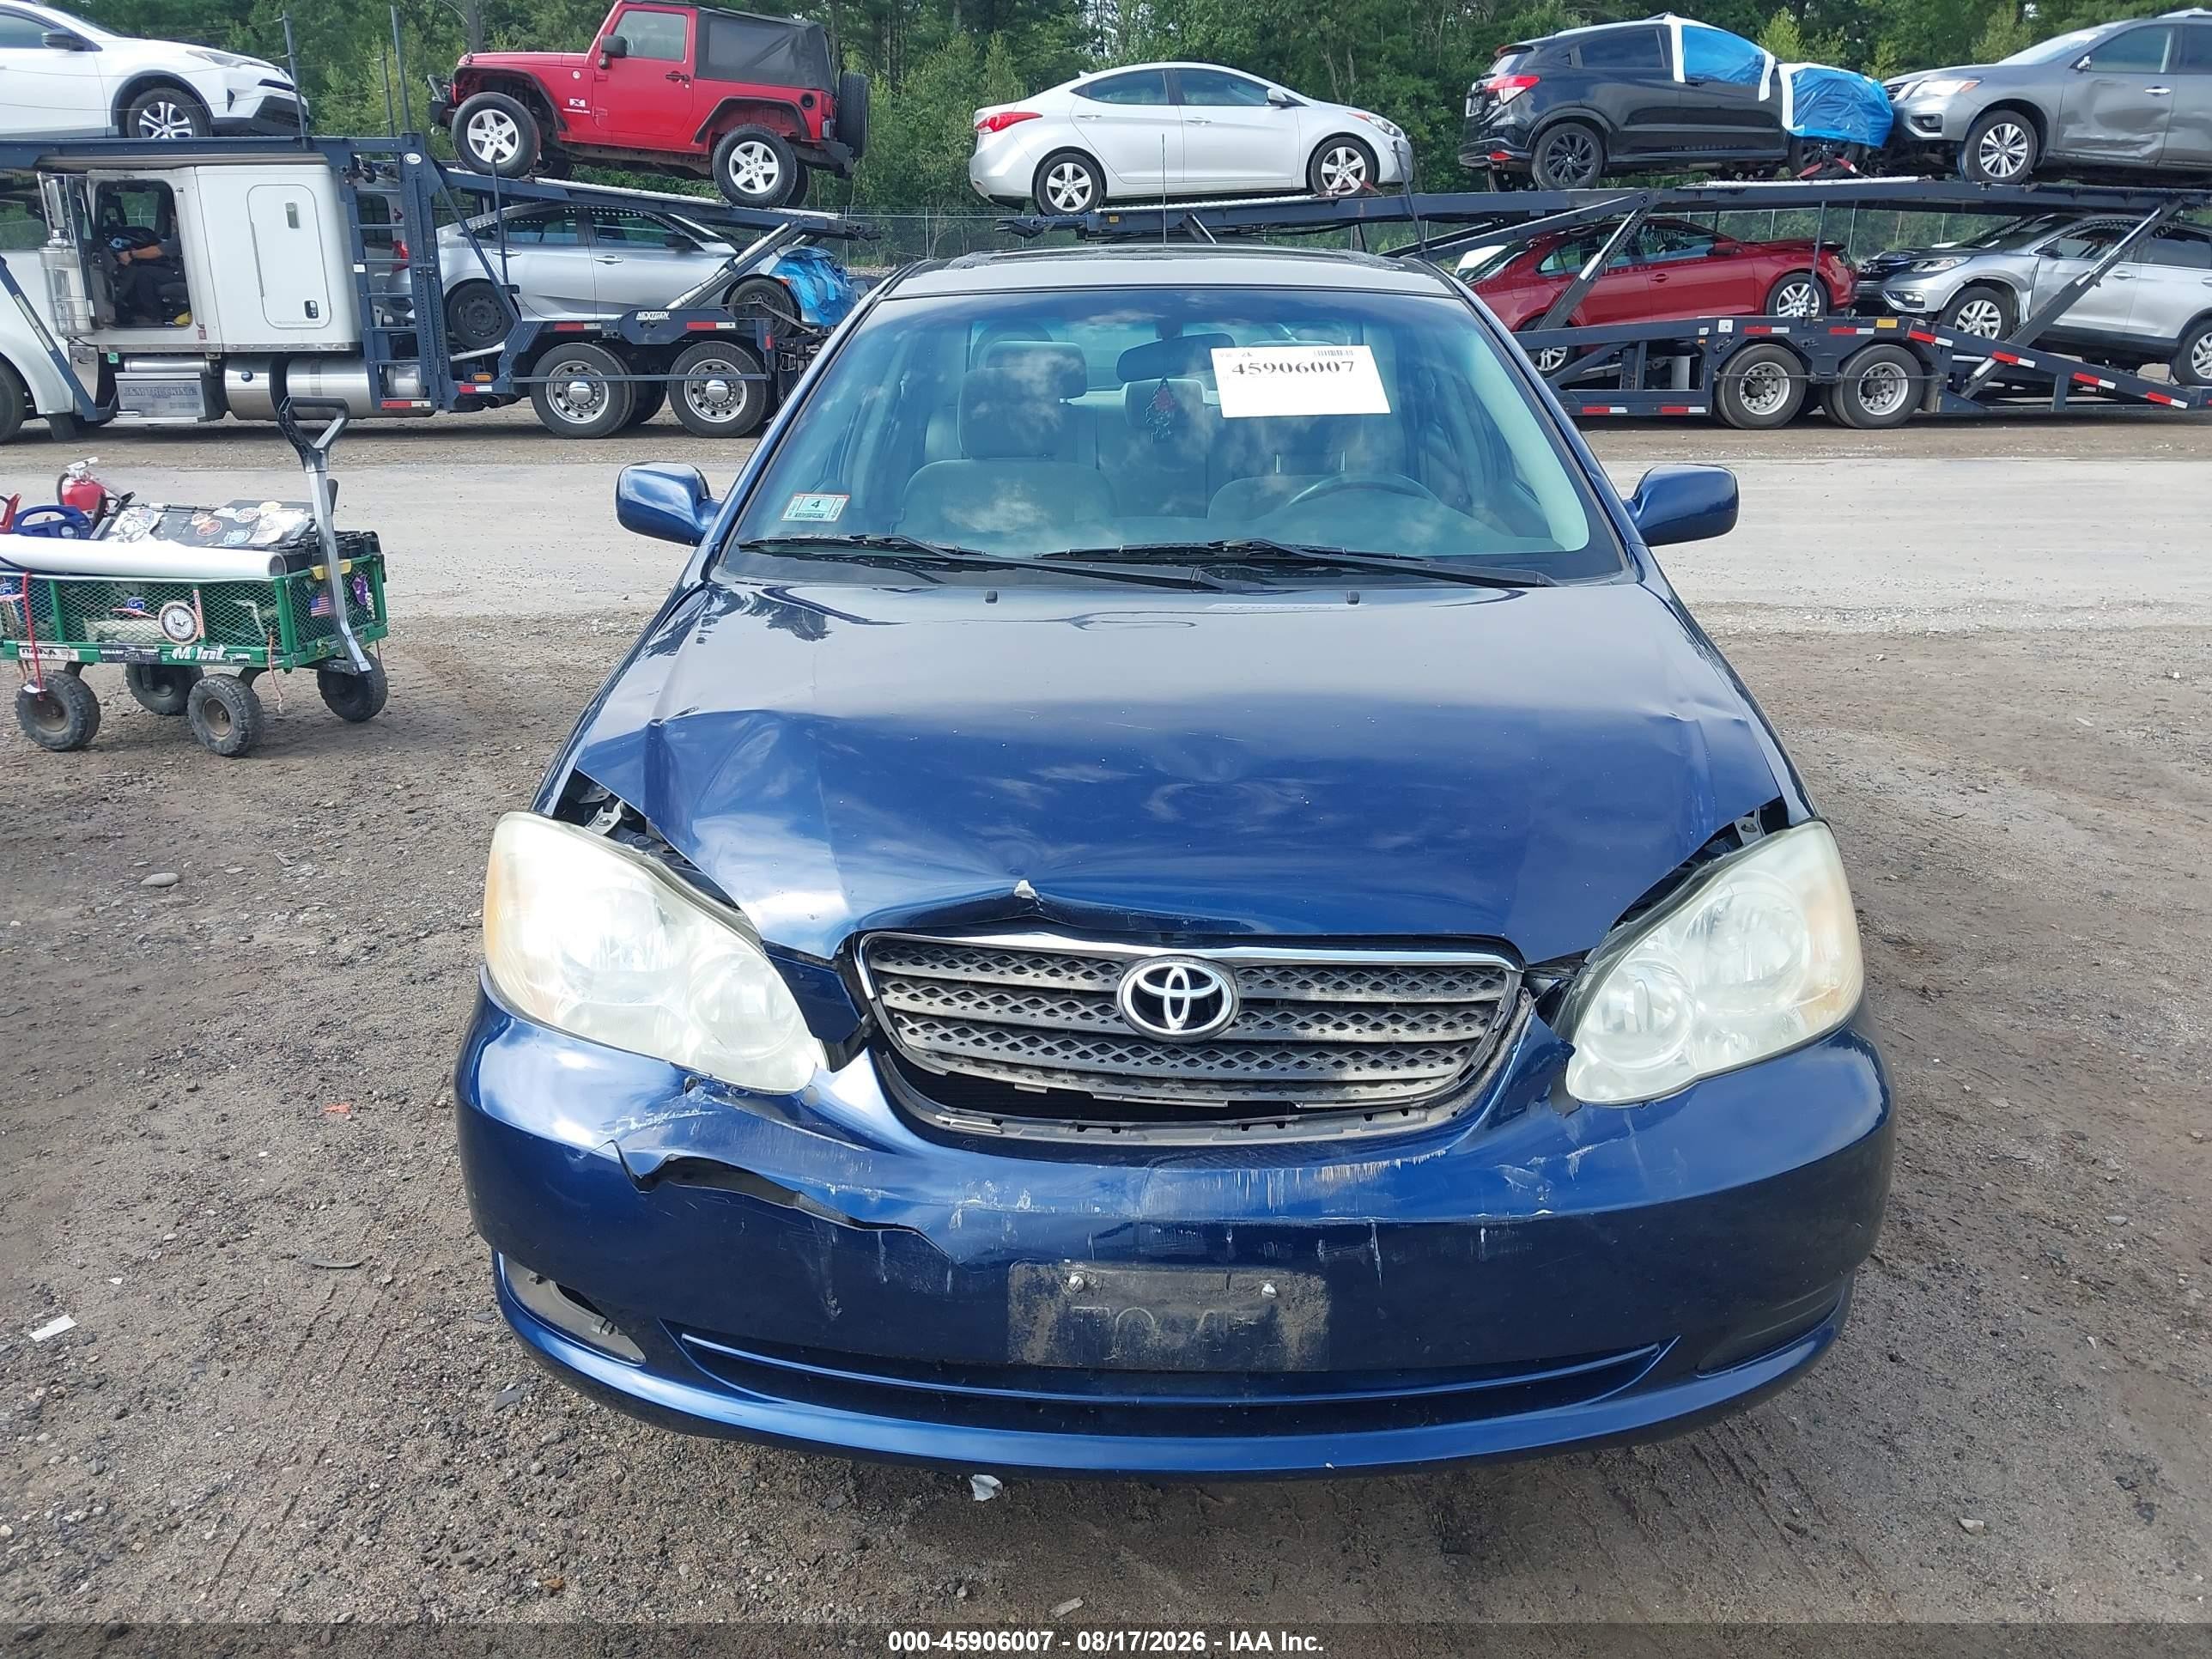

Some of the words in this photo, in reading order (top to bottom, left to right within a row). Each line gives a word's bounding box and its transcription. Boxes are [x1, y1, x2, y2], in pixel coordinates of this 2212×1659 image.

[635, 310, 671, 322] NEXTGEN
[1231, 360, 1355, 376] 45906007
[811, 500, 821, 508] 4
